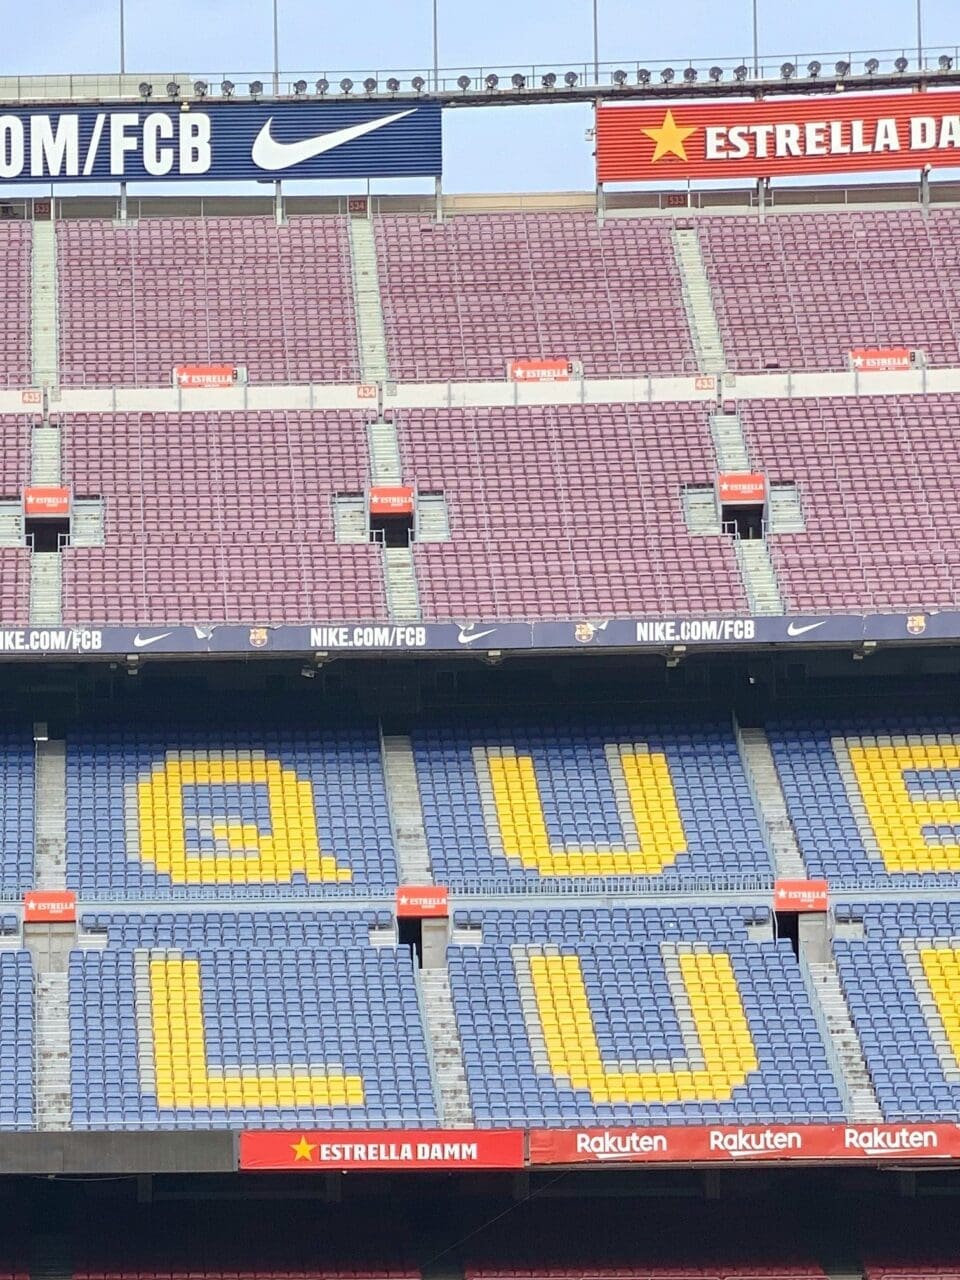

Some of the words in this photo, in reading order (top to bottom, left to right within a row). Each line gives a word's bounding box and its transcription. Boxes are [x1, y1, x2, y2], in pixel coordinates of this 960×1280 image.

[705, 116, 901, 161] ESTRELLA
[668, 195, 684, 206] 533
[350, 201, 365, 211] 534
[865, 358, 907, 367] ESTRELLA
[191, 374, 233, 383] ESTRELLA
[526, 369, 568, 378] ESTRELLA
[695, 378, 714, 390] 433
[23, 391, 41, 403] 435
[357, 386, 376, 398] 434
[729, 483, 762, 491] ESTRELLA
[380, 496, 413, 504] ESTRELLA
[637, 620, 754, 642] NIKE.COM/FCB
[310, 626, 425, 647] NIKE.COM/FCB
[788, 891, 825, 899] ESTRELLA
[38, 902, 74, 910] ESTRELLA
[410, 897, 446, 905] ESTRELLA
[577, 1131, 667, 1153] Rakuten
[710, 1129, 801, 1151] Rakuten
[845, 1127, 937, 1149] Rakuten
[320, 1144, 412, 1161] ESTRELLA
[416, 1143, 477, 1160] DAMM
